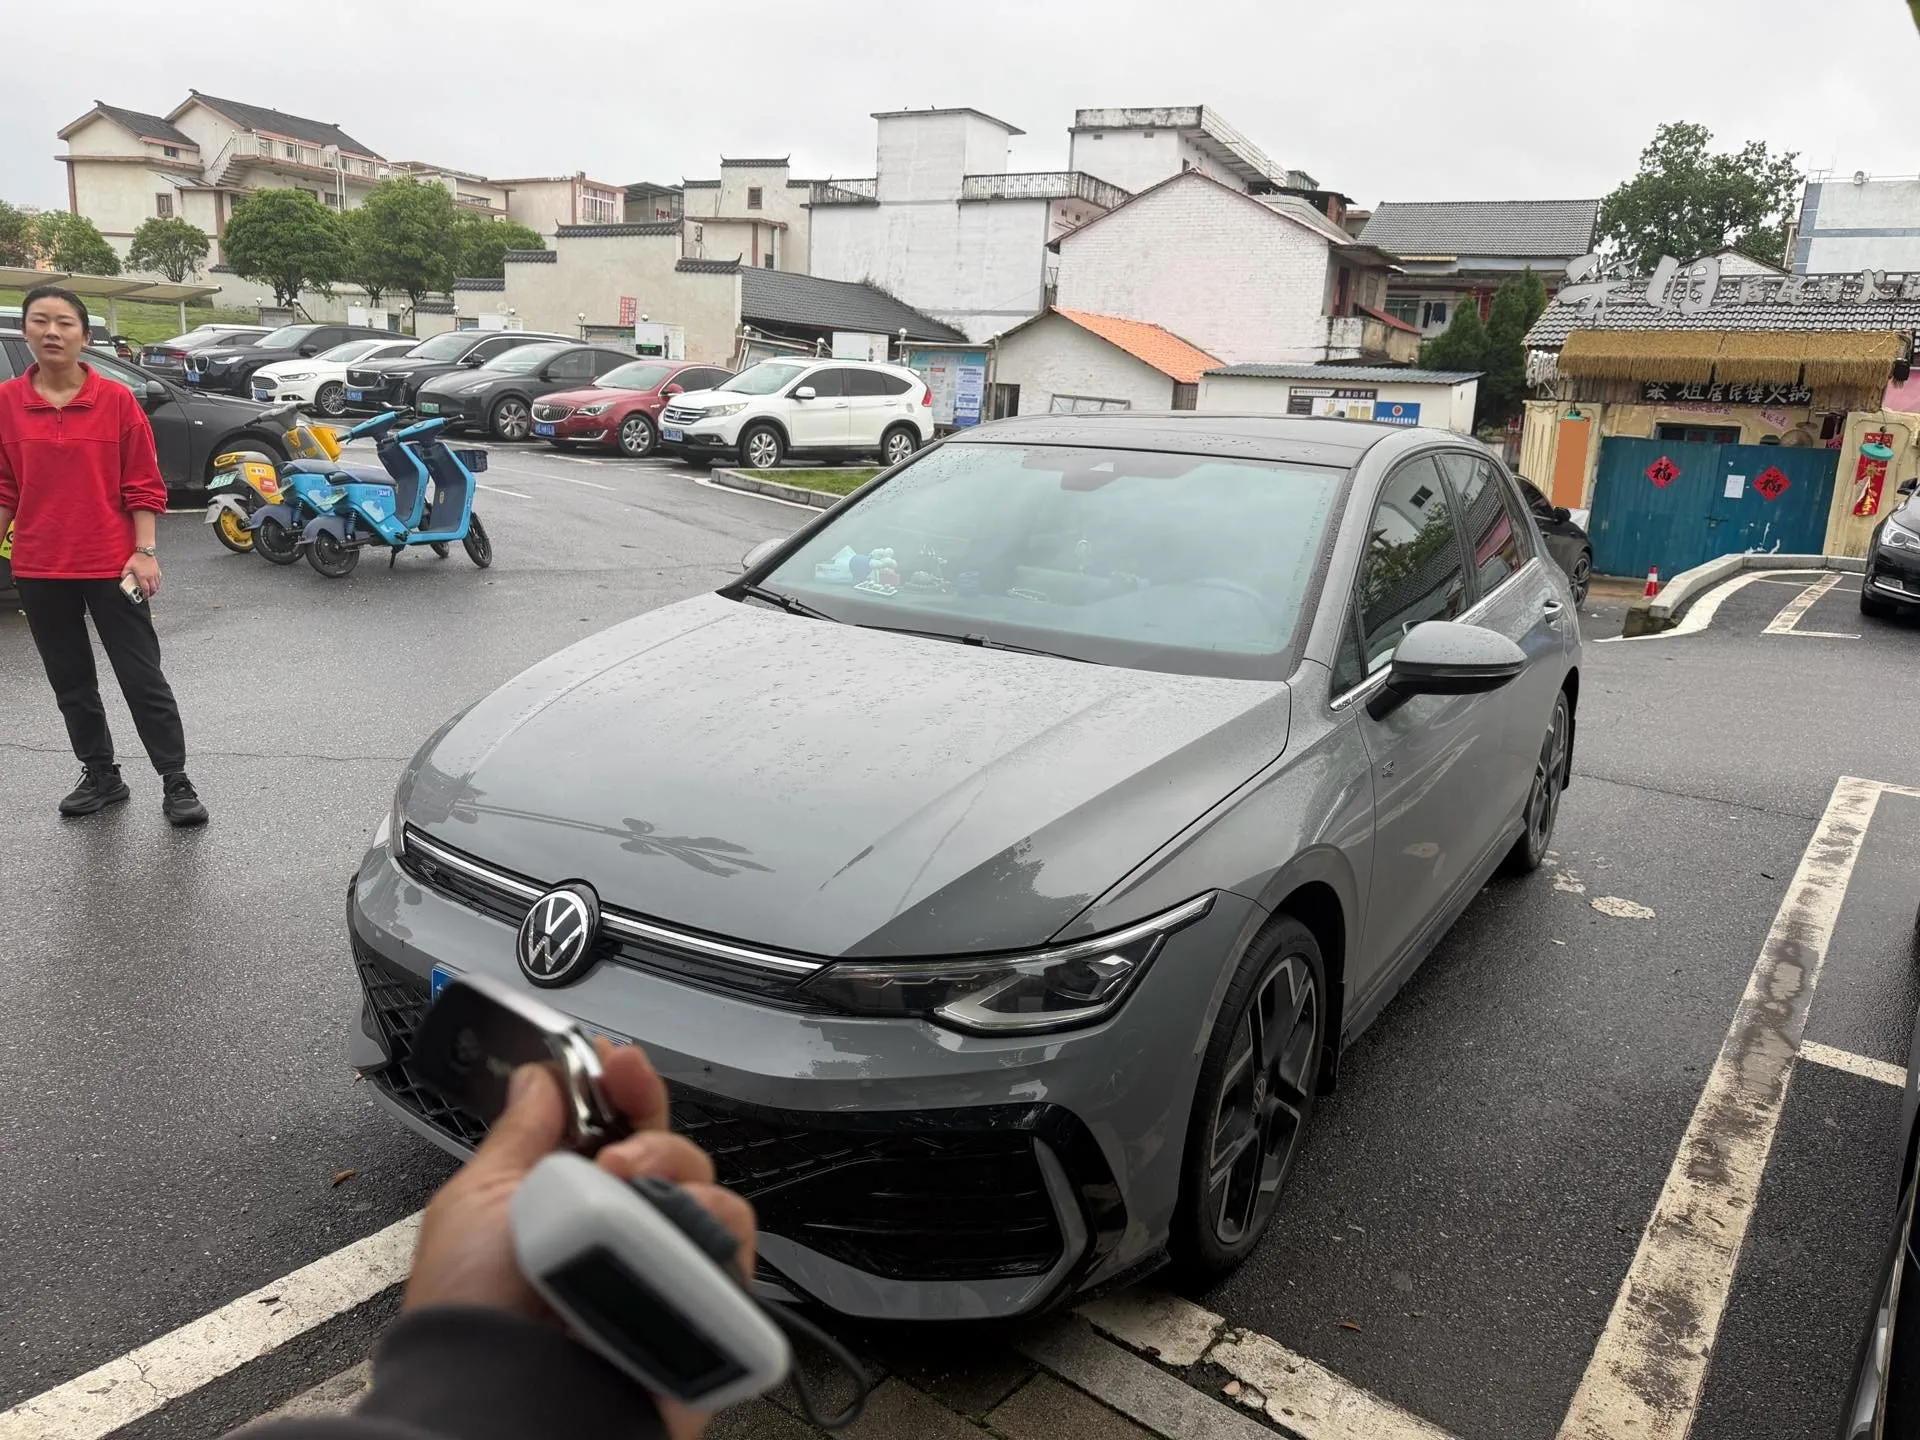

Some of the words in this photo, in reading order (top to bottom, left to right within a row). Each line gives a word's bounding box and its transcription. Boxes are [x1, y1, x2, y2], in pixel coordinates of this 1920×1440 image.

[1556, 253, 1724, 322] 笨姐
[1646, 382, 1812, 403] 笨姐居民楼火锅
[1651, 462, 1673, 482] 福
[1760, 473, 1783, 493] 福
